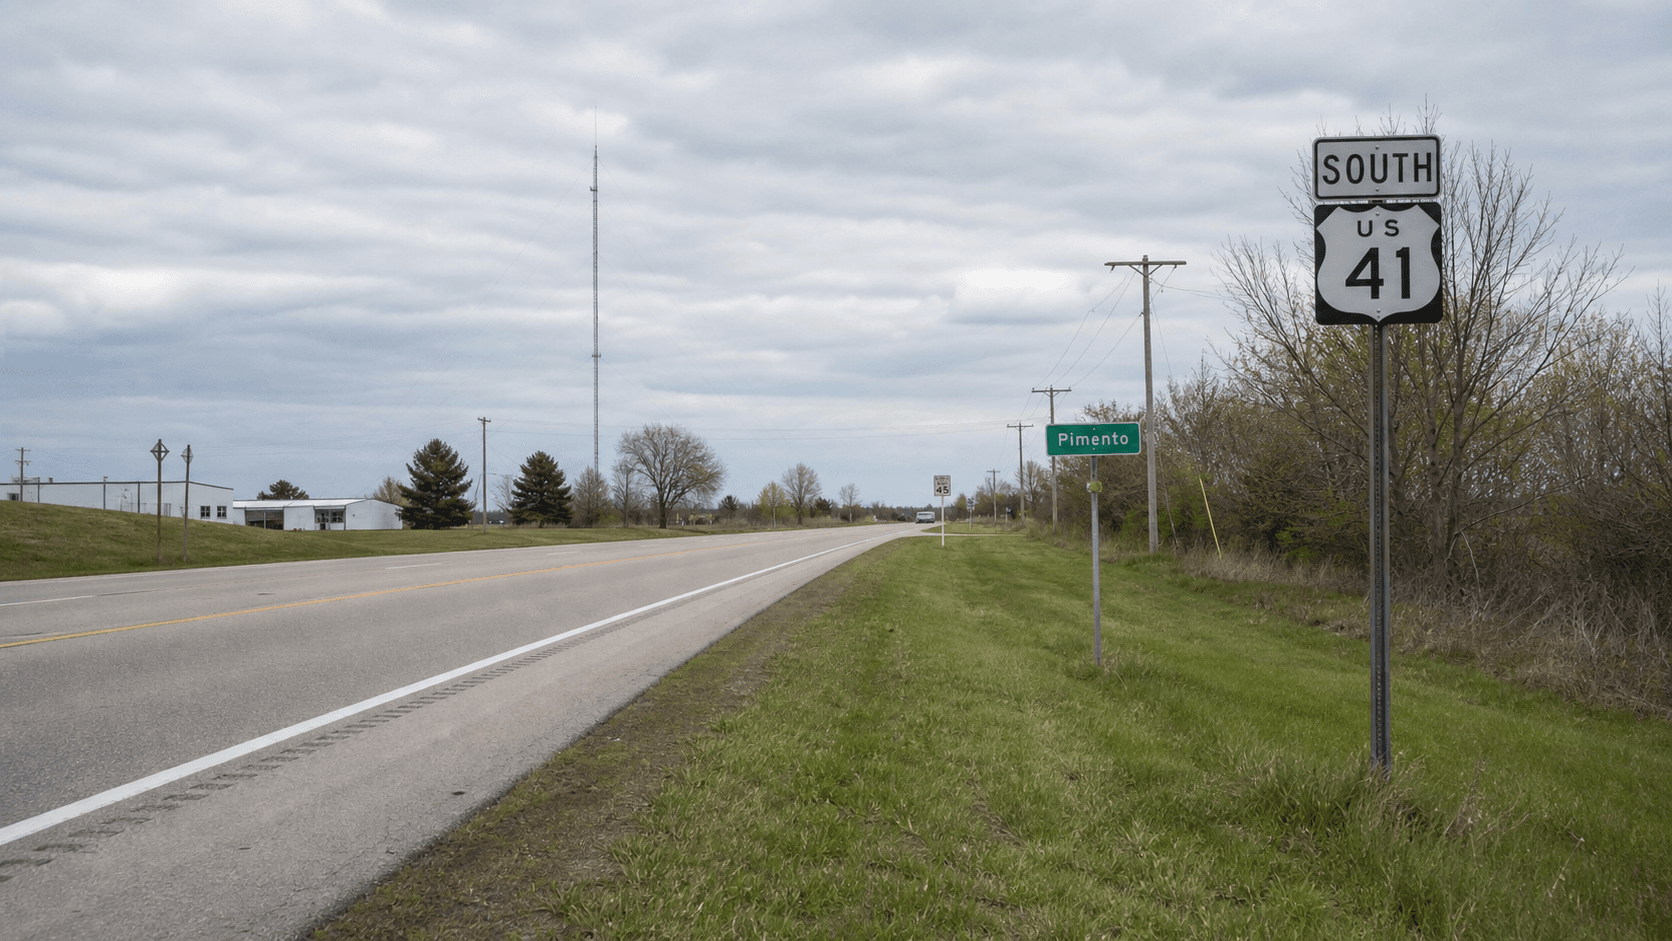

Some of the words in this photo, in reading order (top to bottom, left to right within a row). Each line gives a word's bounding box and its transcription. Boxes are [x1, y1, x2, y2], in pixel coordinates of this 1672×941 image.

[1322, 152, 1432, 185] SOUTH
[1345, 247, 1411, 299] 41
[1058, 431, 1128, 446] Pimento
[936, 486, 949, 494] 45
